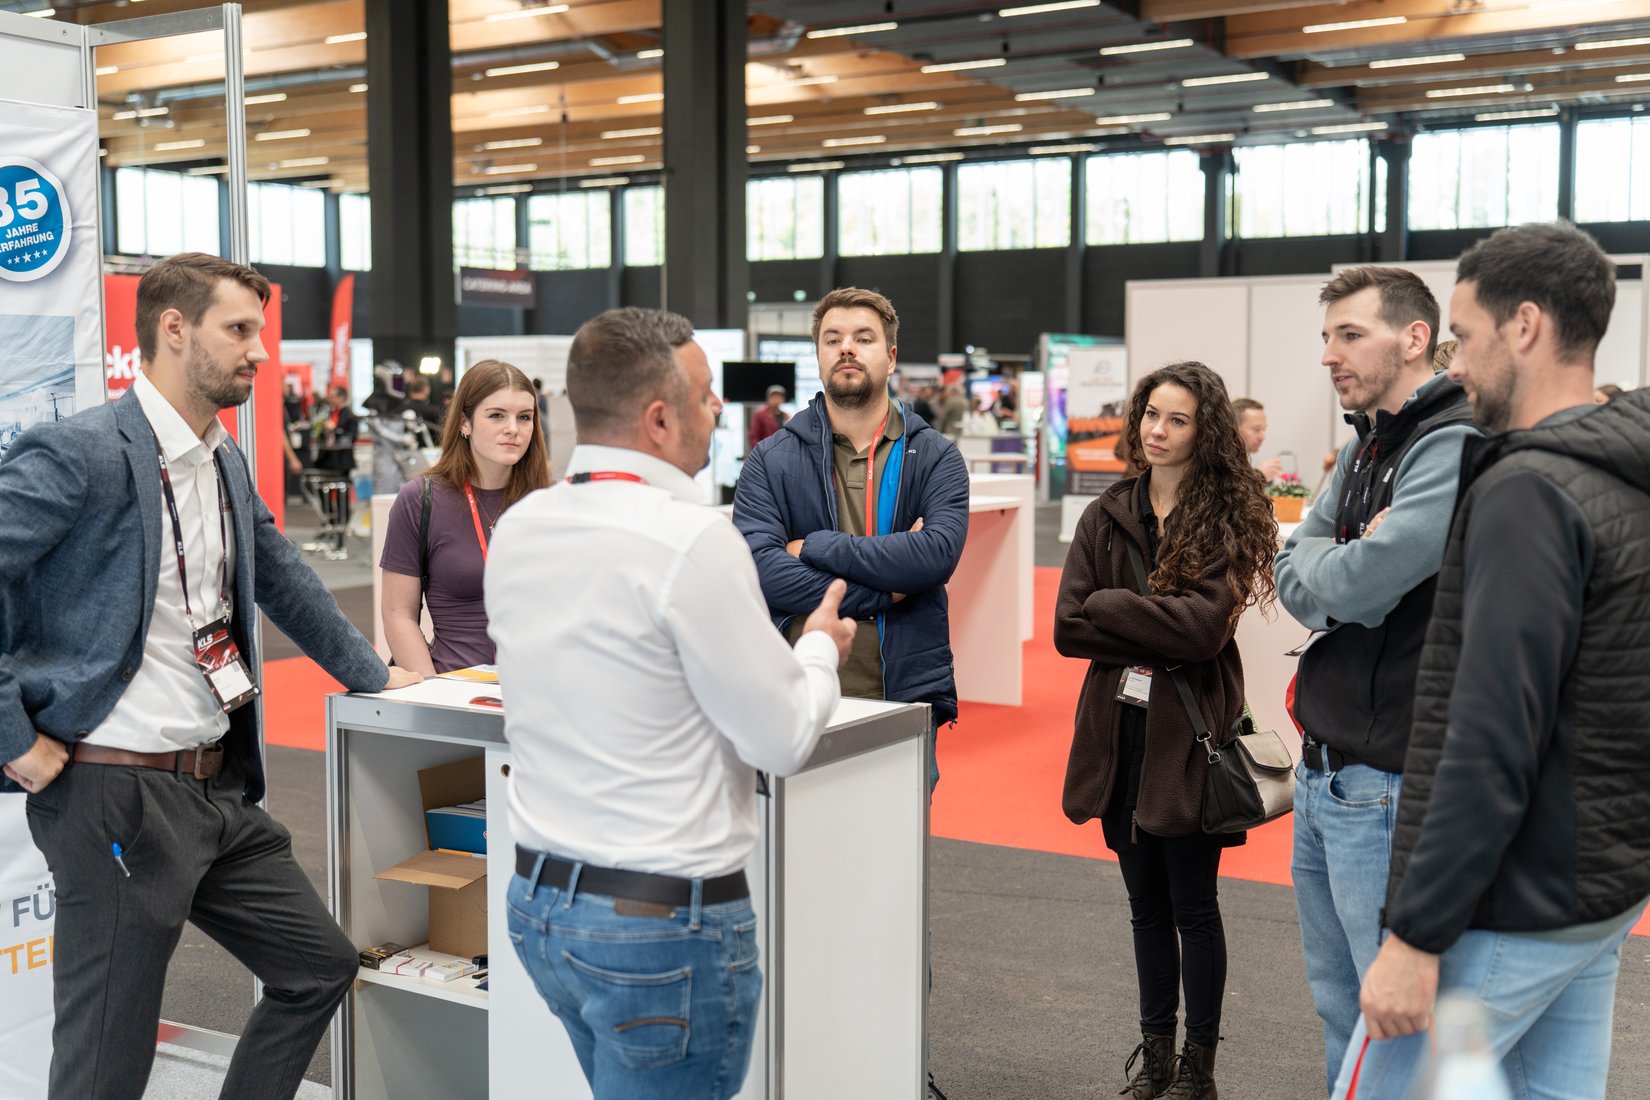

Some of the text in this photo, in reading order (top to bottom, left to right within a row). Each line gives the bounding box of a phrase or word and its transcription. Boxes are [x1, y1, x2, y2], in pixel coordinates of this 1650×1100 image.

[6, 222, 39, 239] JAHRE
[0, 231, 54, 253] RFAHRUNG
[197, 633, 213, 649] KLS
[0, 935, 54, 974] TE
